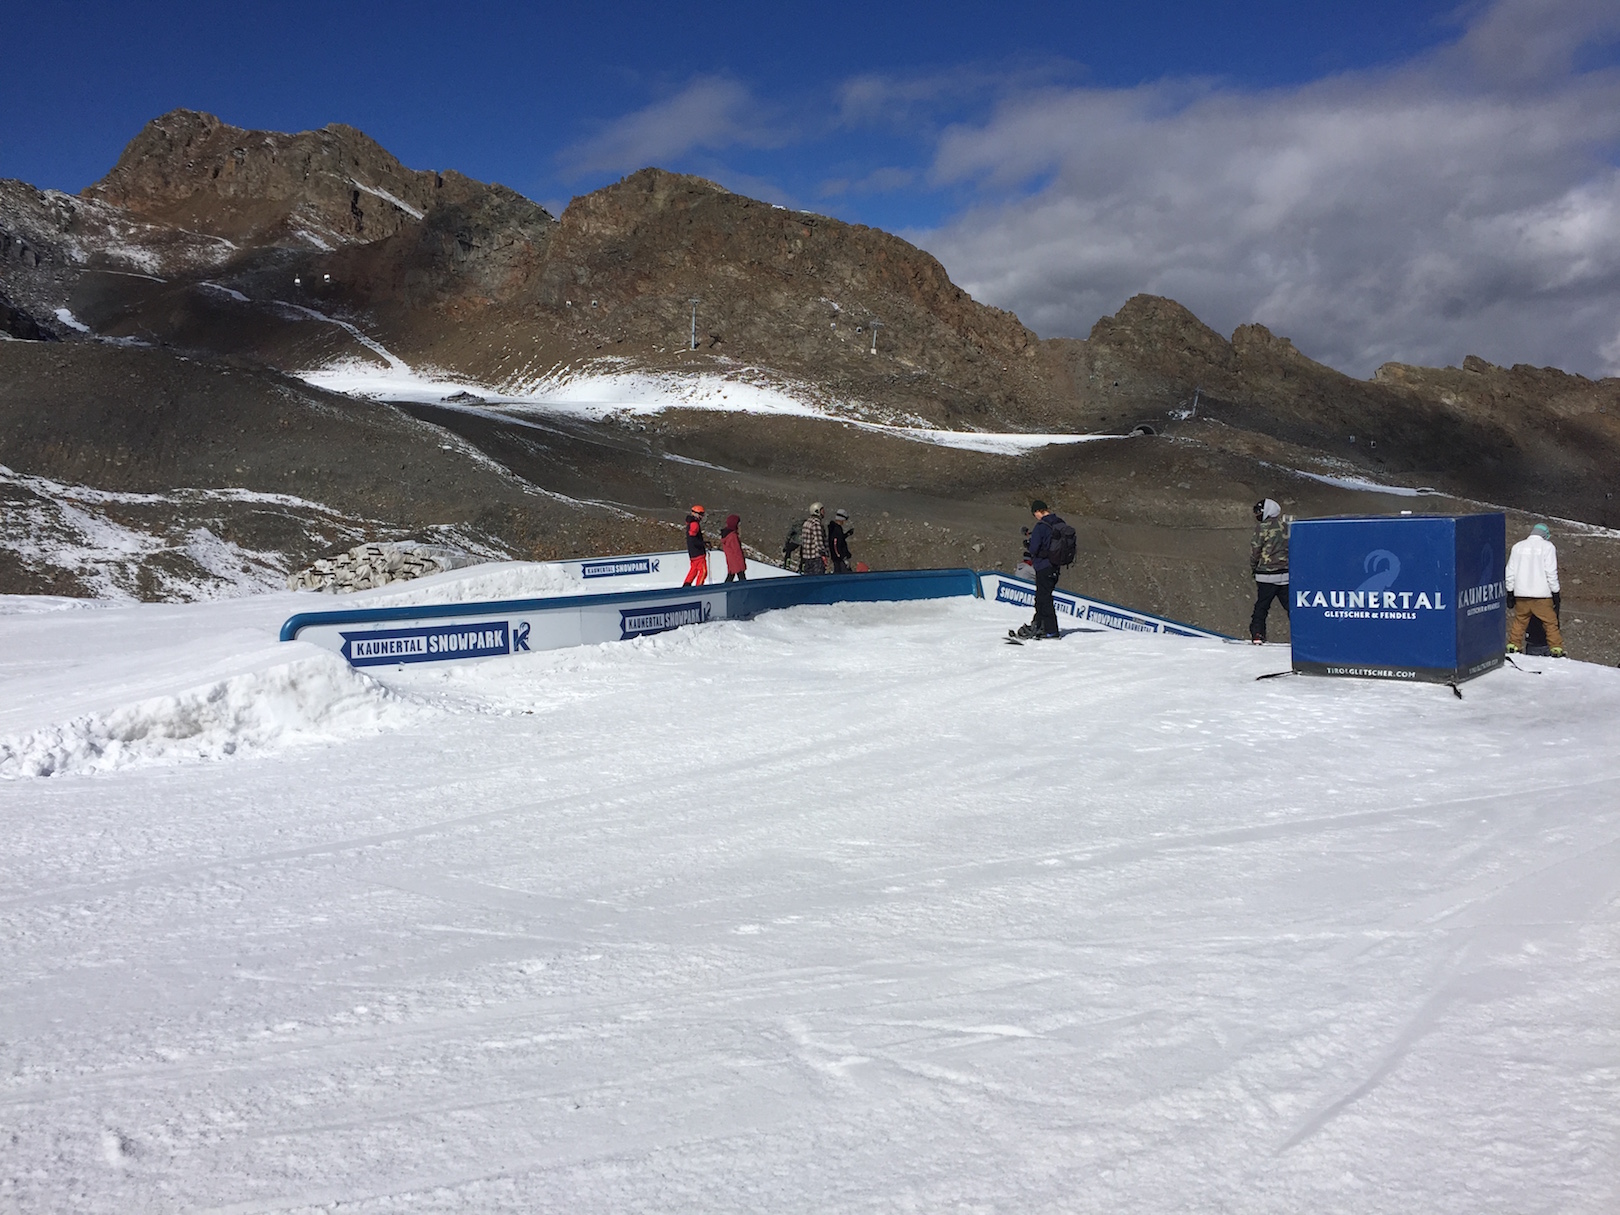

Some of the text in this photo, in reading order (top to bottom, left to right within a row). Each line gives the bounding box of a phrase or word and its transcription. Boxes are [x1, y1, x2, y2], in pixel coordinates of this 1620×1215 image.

[615, 562, 648, 573] SNOWPARK
[1296, 590, 1447, 610] KAUNERTAL
[628, 614, 663, 630] KAUNERTAL
[665, 607, 701, 628] SNOWPARK
[1324, 610, 1371, 619] GLETSCHER
[1380, 611, 1417, 620] FENDELS
[357, 638, 423, 656] KAUNERTAL
[429, 629, 504, 653] SNOWPARK
[1326, 667, 1416, 678] TIROLGLETSCHER.COM
